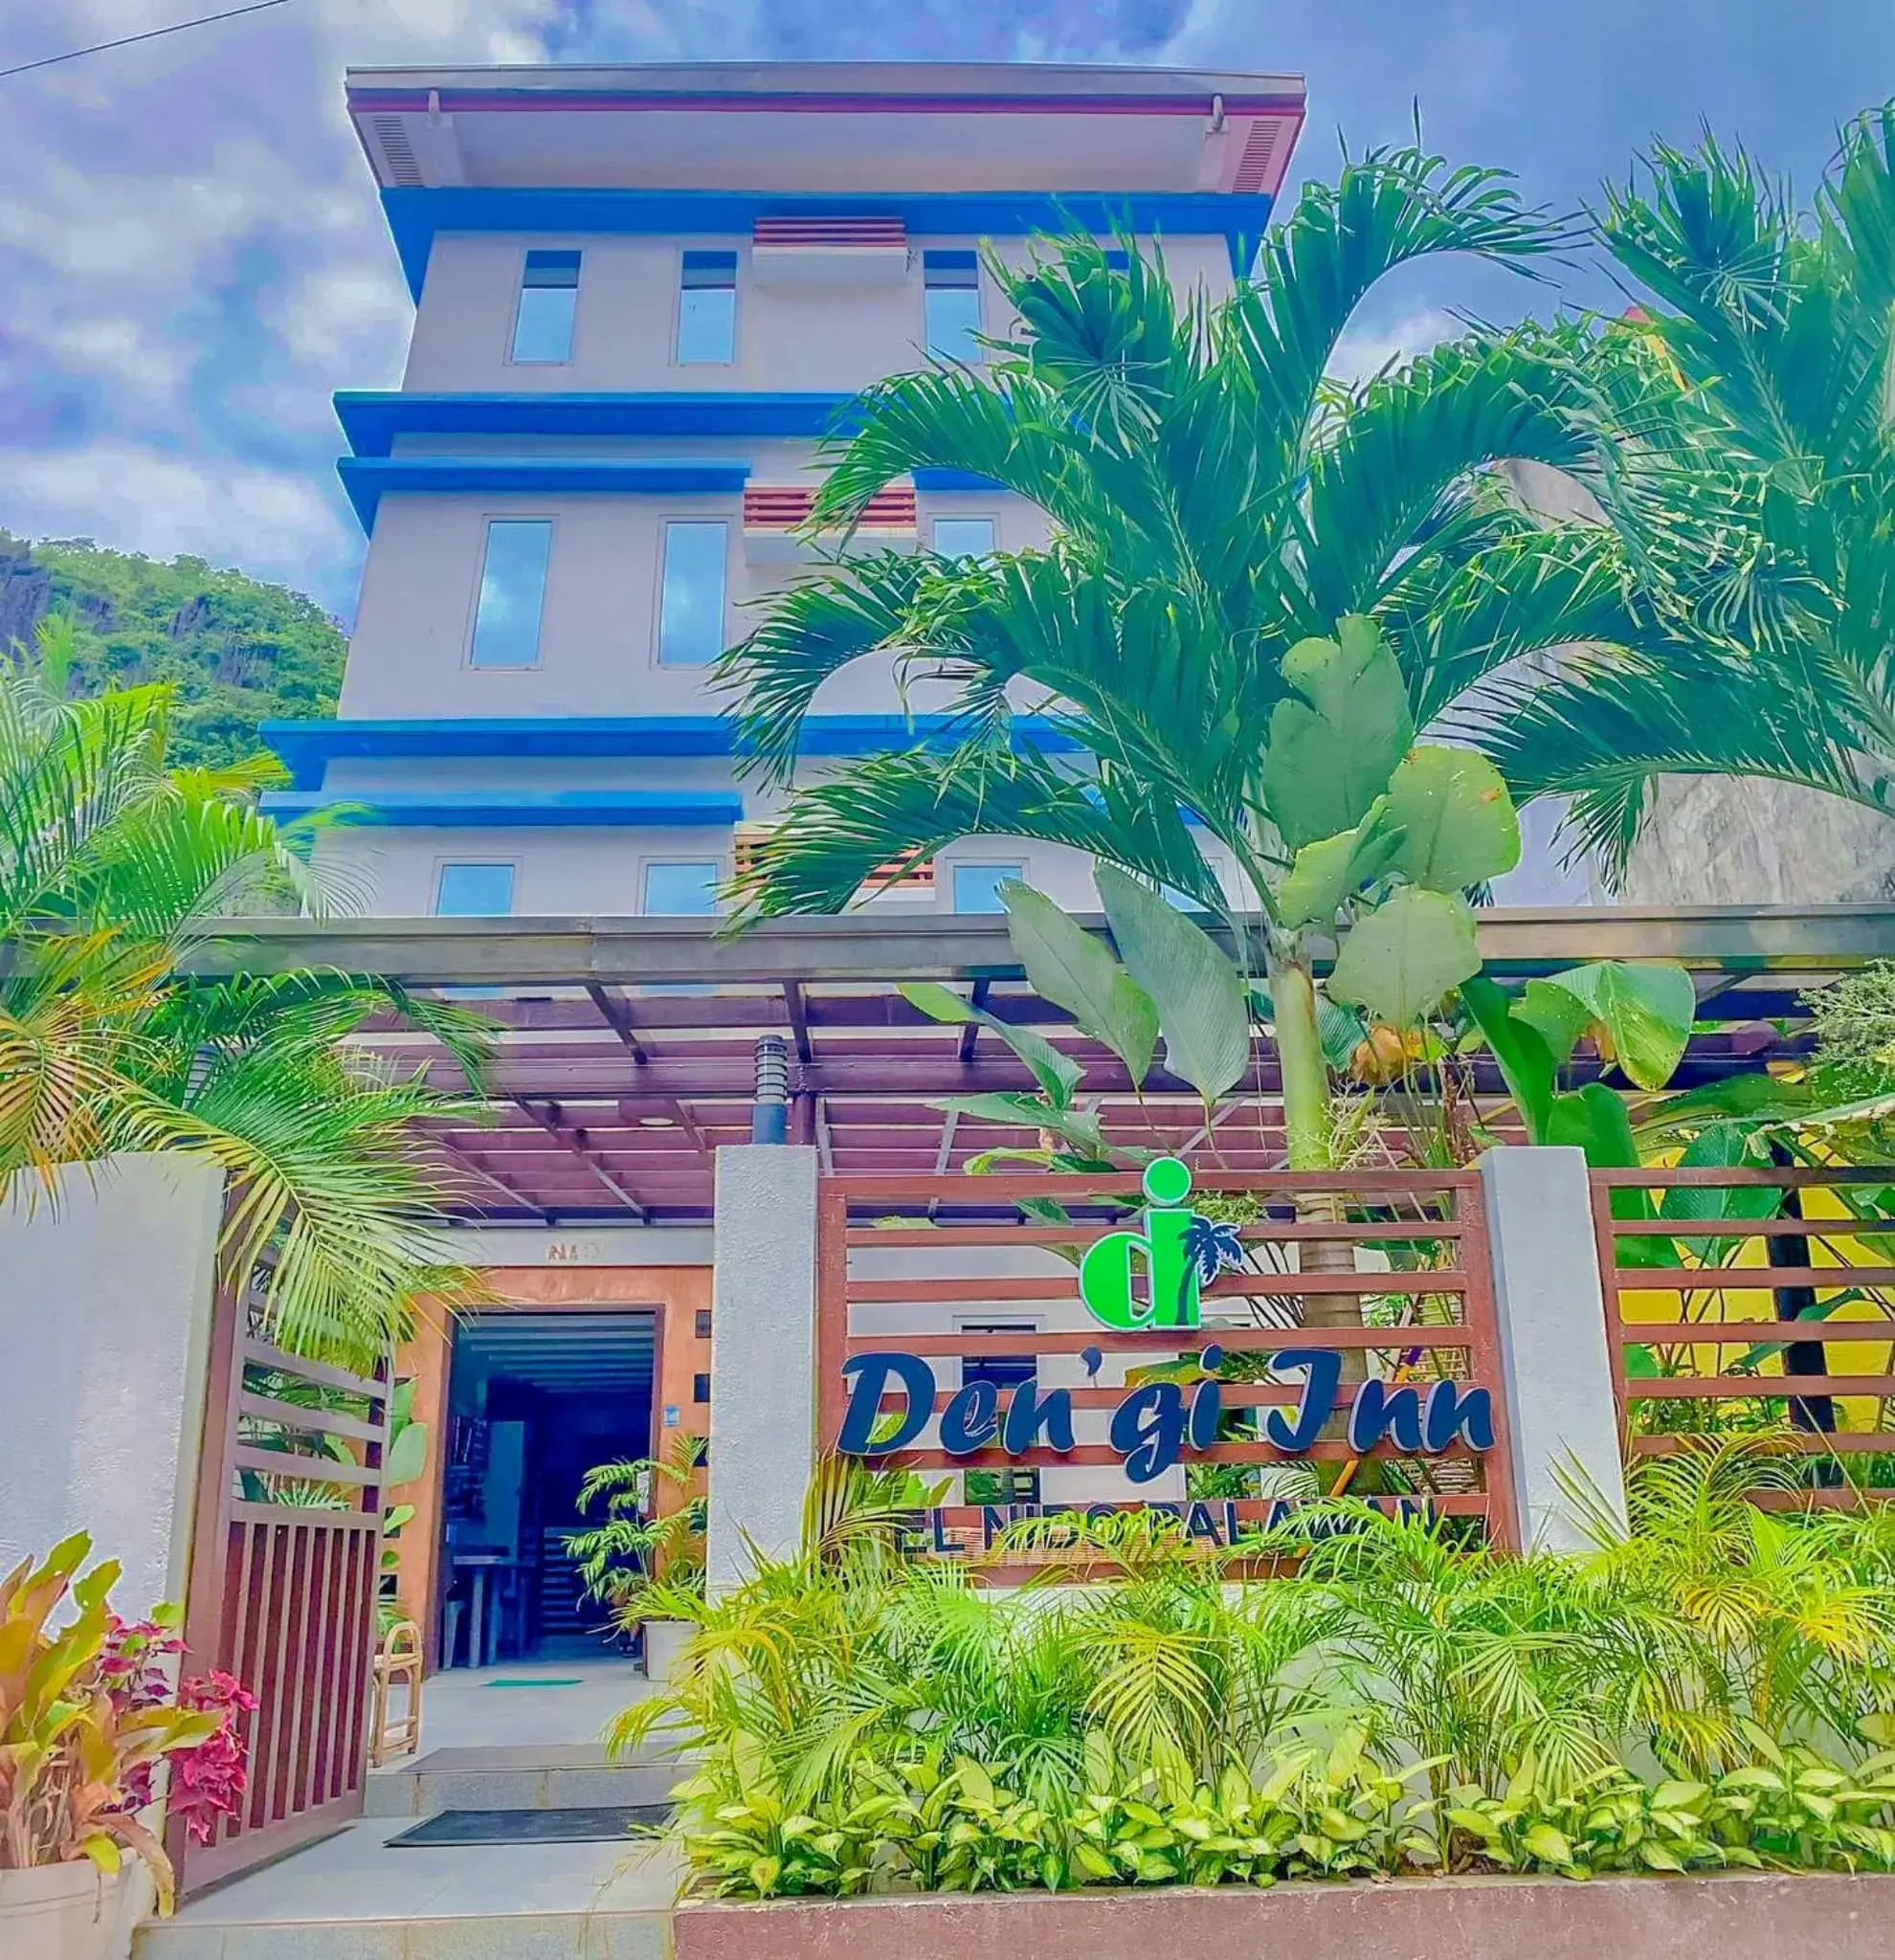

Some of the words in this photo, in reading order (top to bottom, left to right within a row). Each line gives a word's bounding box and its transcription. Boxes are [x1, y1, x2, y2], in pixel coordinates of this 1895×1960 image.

[836, 1343, 1222, 1483] Den'gi
[1260, 1347, 1496, 1454] Inn
[893, 1506, 965, 1552] EL
